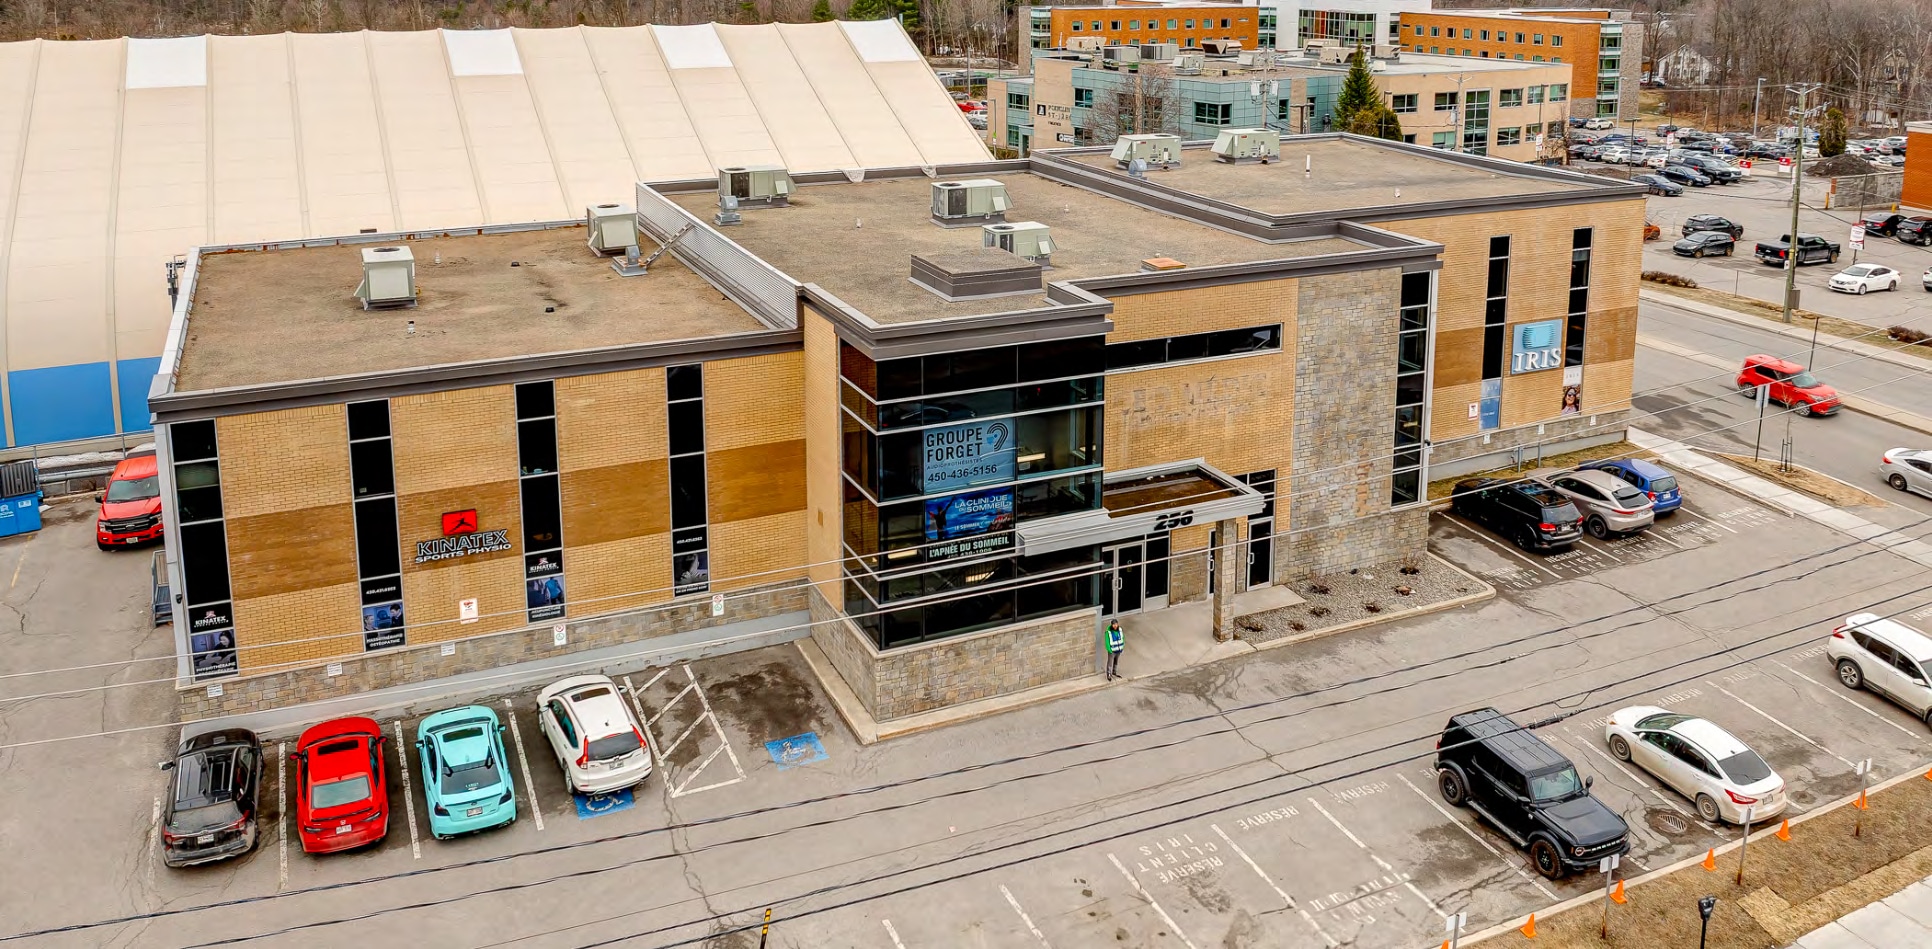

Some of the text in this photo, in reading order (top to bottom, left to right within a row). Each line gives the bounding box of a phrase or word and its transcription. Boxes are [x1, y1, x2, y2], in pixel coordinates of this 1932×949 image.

[1514, 348, 1562, 372] IRIS
[926, 427, 983, 447] GROUPE
[927, 442, 983, 463] FORGET
[928, 464, 997, 482] 450-436-5156
[1154, 510, 1194, 531] 256
[415, 543, 512, 564] SPORTS PHYSIO
[417, 529, 509, 557] KINATEX
[929, 543, 958, 558] L'APNÉE
[960, 541, 971, 552] DU
[972, 536, 1010, 550] SOMMEIL
[195, 615, 227, 626] KINATEX
[1139, 834, 1194, 856] IRIS
[1137, 841, 1218, 872] CLIENT
